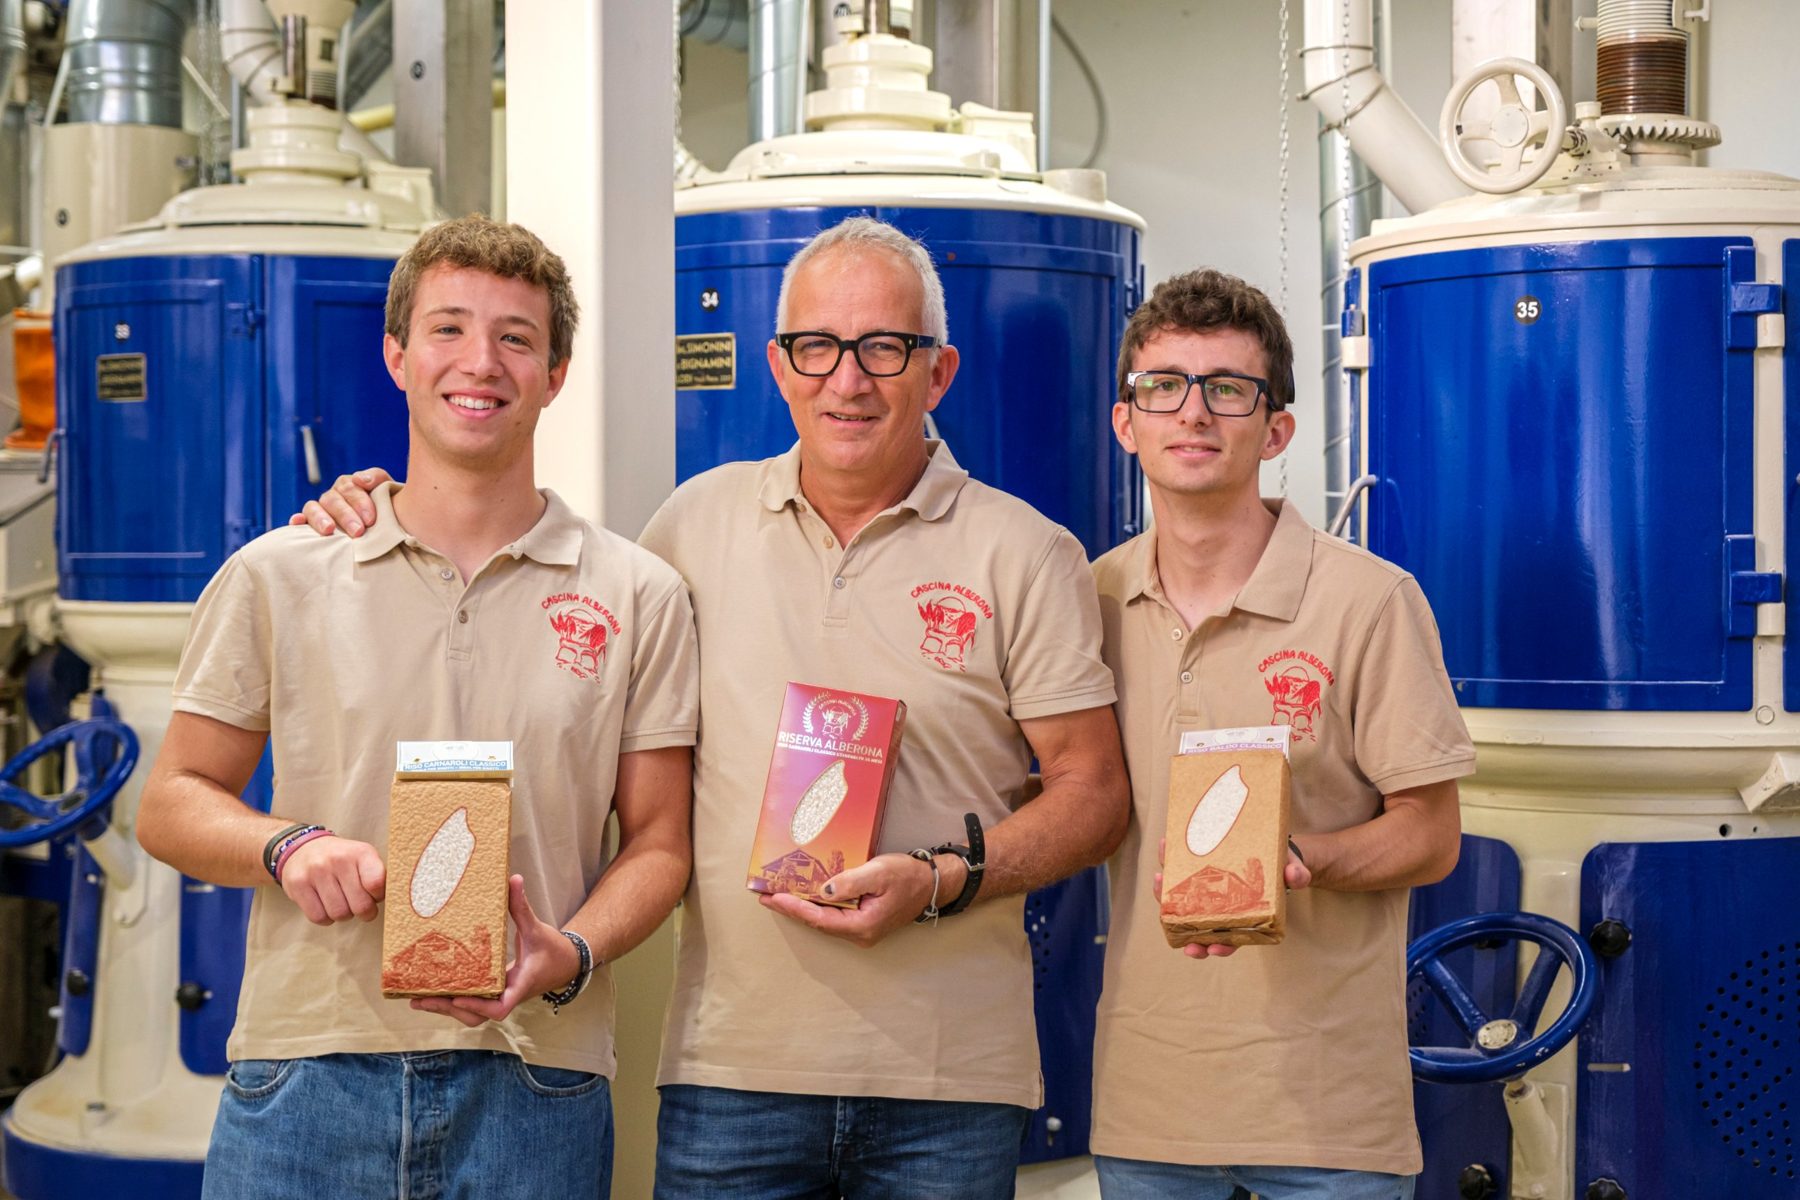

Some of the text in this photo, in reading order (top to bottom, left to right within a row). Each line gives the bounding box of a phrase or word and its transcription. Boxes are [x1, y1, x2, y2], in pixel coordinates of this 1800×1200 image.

[702, 291, 719, 308] 34
[1516, 301, 1539, 319] 35
[911, 581, 994, 620] CASCINA ALBERONA
[541, 592, 622, 636] CASCINA ALBERONA
[1258, 649, 1335, 687] CASCINA ALBERONA
[778, 731, 823, 749] RISERVA
[824, 739, 883, 759] ALBERONA
[1210, 743, 1238, 752] BALDO
[1239, 742, 1282, 750] CLASSICO
[424, 759, 468, 768] CARNAROLI
[469, 760, 506, 768] CLASSICO
